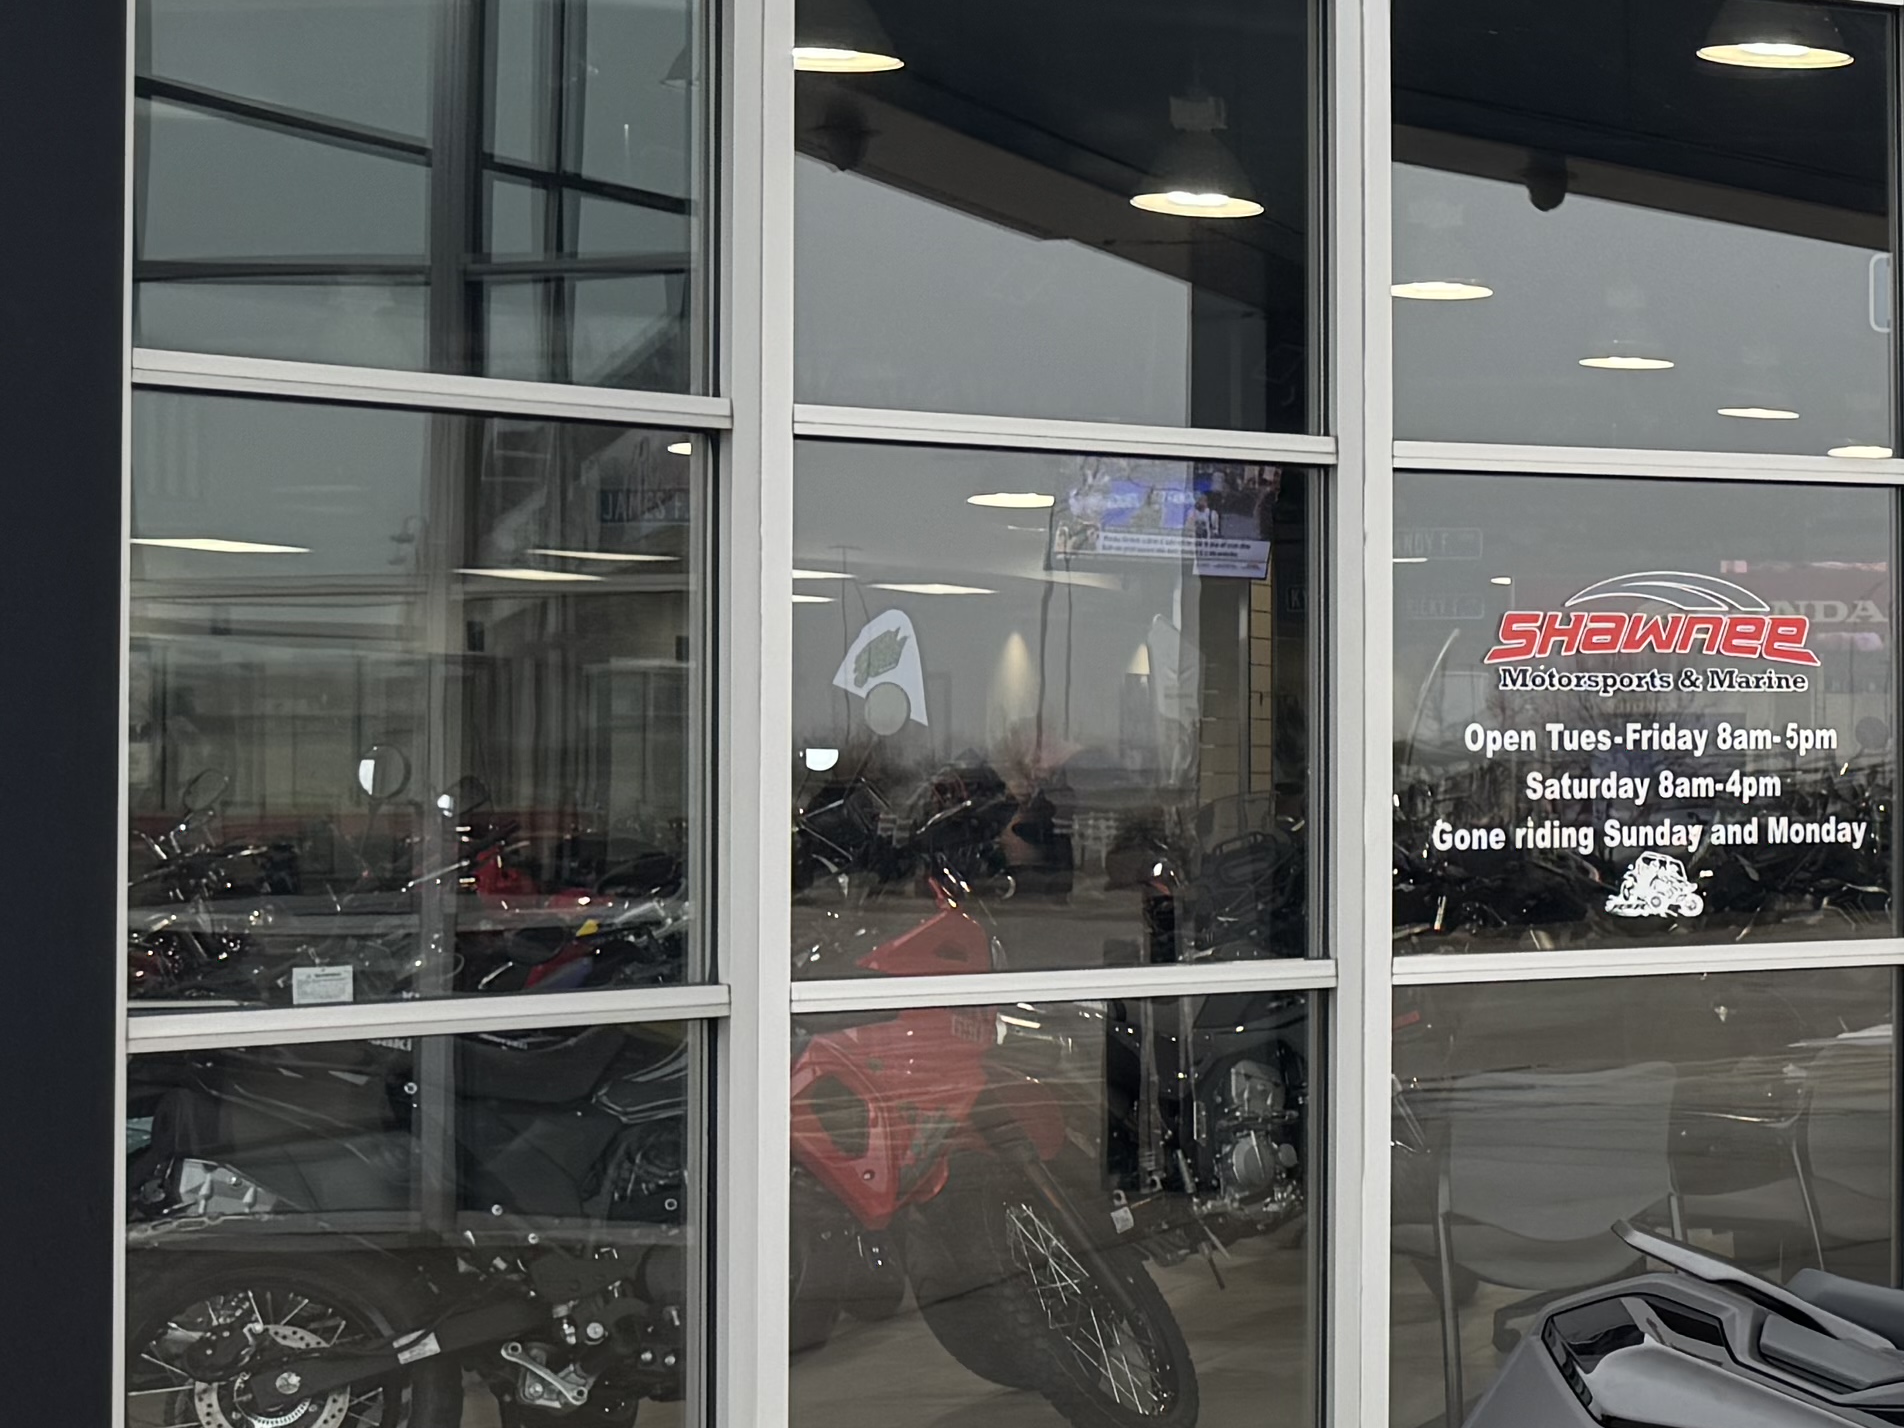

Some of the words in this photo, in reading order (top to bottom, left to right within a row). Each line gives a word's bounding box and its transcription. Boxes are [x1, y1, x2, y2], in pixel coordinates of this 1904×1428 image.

[1484, 610, 1821, 668] SHAWNEE
[1499, 665, 1674, 696] Motorsports
[1679, 668, 1703, 692] &
[1707, 667, 1809, 693] Marine
[1464, 723, 1537, 758] Open
[1545, 723, 1708, 757] Tues-Friday
[1525, 771, 1651, 806] Saturday
[1658, 769, 1782, 801] 8am-4pm
[1432, 819, 1506, 851] Gone
[1515, 816, 1595, 855] riding
[1603, 818, 1702, 853] Sunday
[1710, 817, 1759, 846] and
[1767, 815, 1868, 849] Monday
